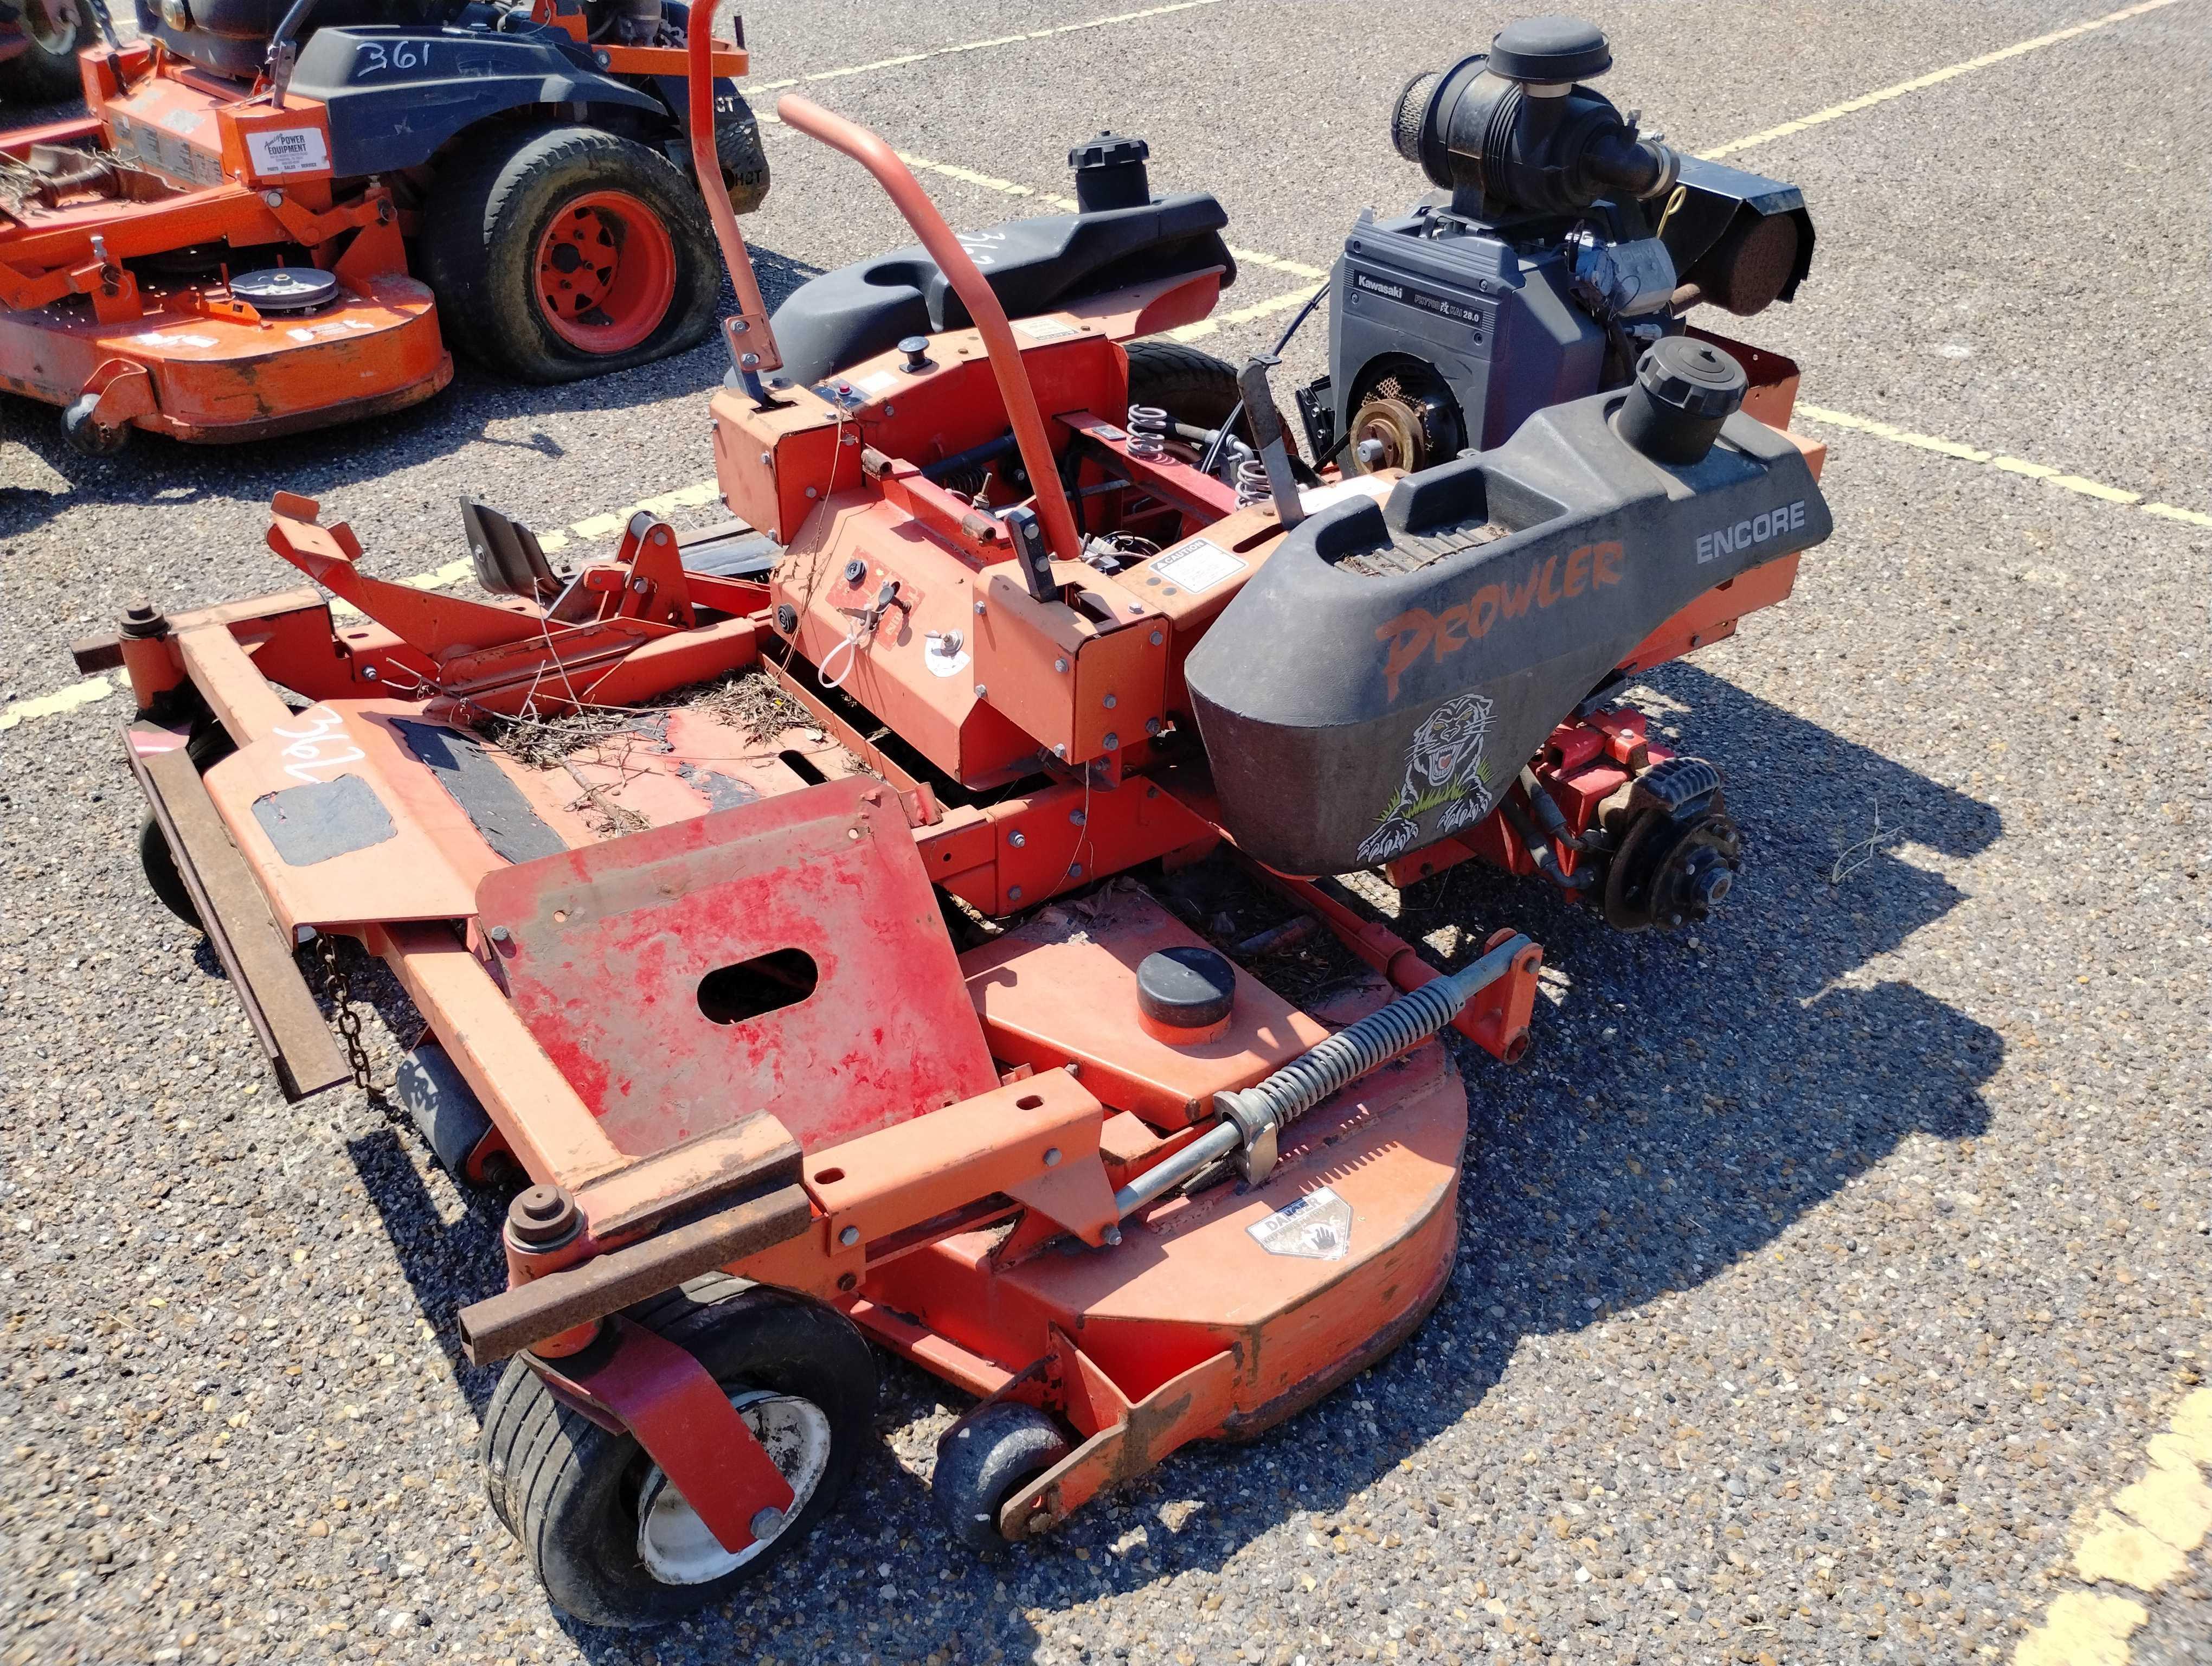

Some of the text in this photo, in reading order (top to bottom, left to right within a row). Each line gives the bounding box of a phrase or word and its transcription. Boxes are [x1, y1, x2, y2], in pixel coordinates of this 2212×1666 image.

[356, 40, 430, 77] 361
[717, 96, 734, 112] OT
[268, 143, 307, 155] EQUIPMENT
[281, 135, 305, 145] POWER
[1358, 275, 1403, 299] Kawasaki
[1463, 311, 1479, 323] 28.0
[1696, 500, 1805, 565] ENCORE
[1164, 540, 1205, 564] CAUTION
[1375, 541, 1623, 703] PROWLER
[272, 706, 366, 784] 362
[1265, 1197, 1321, 1231] DANGER
